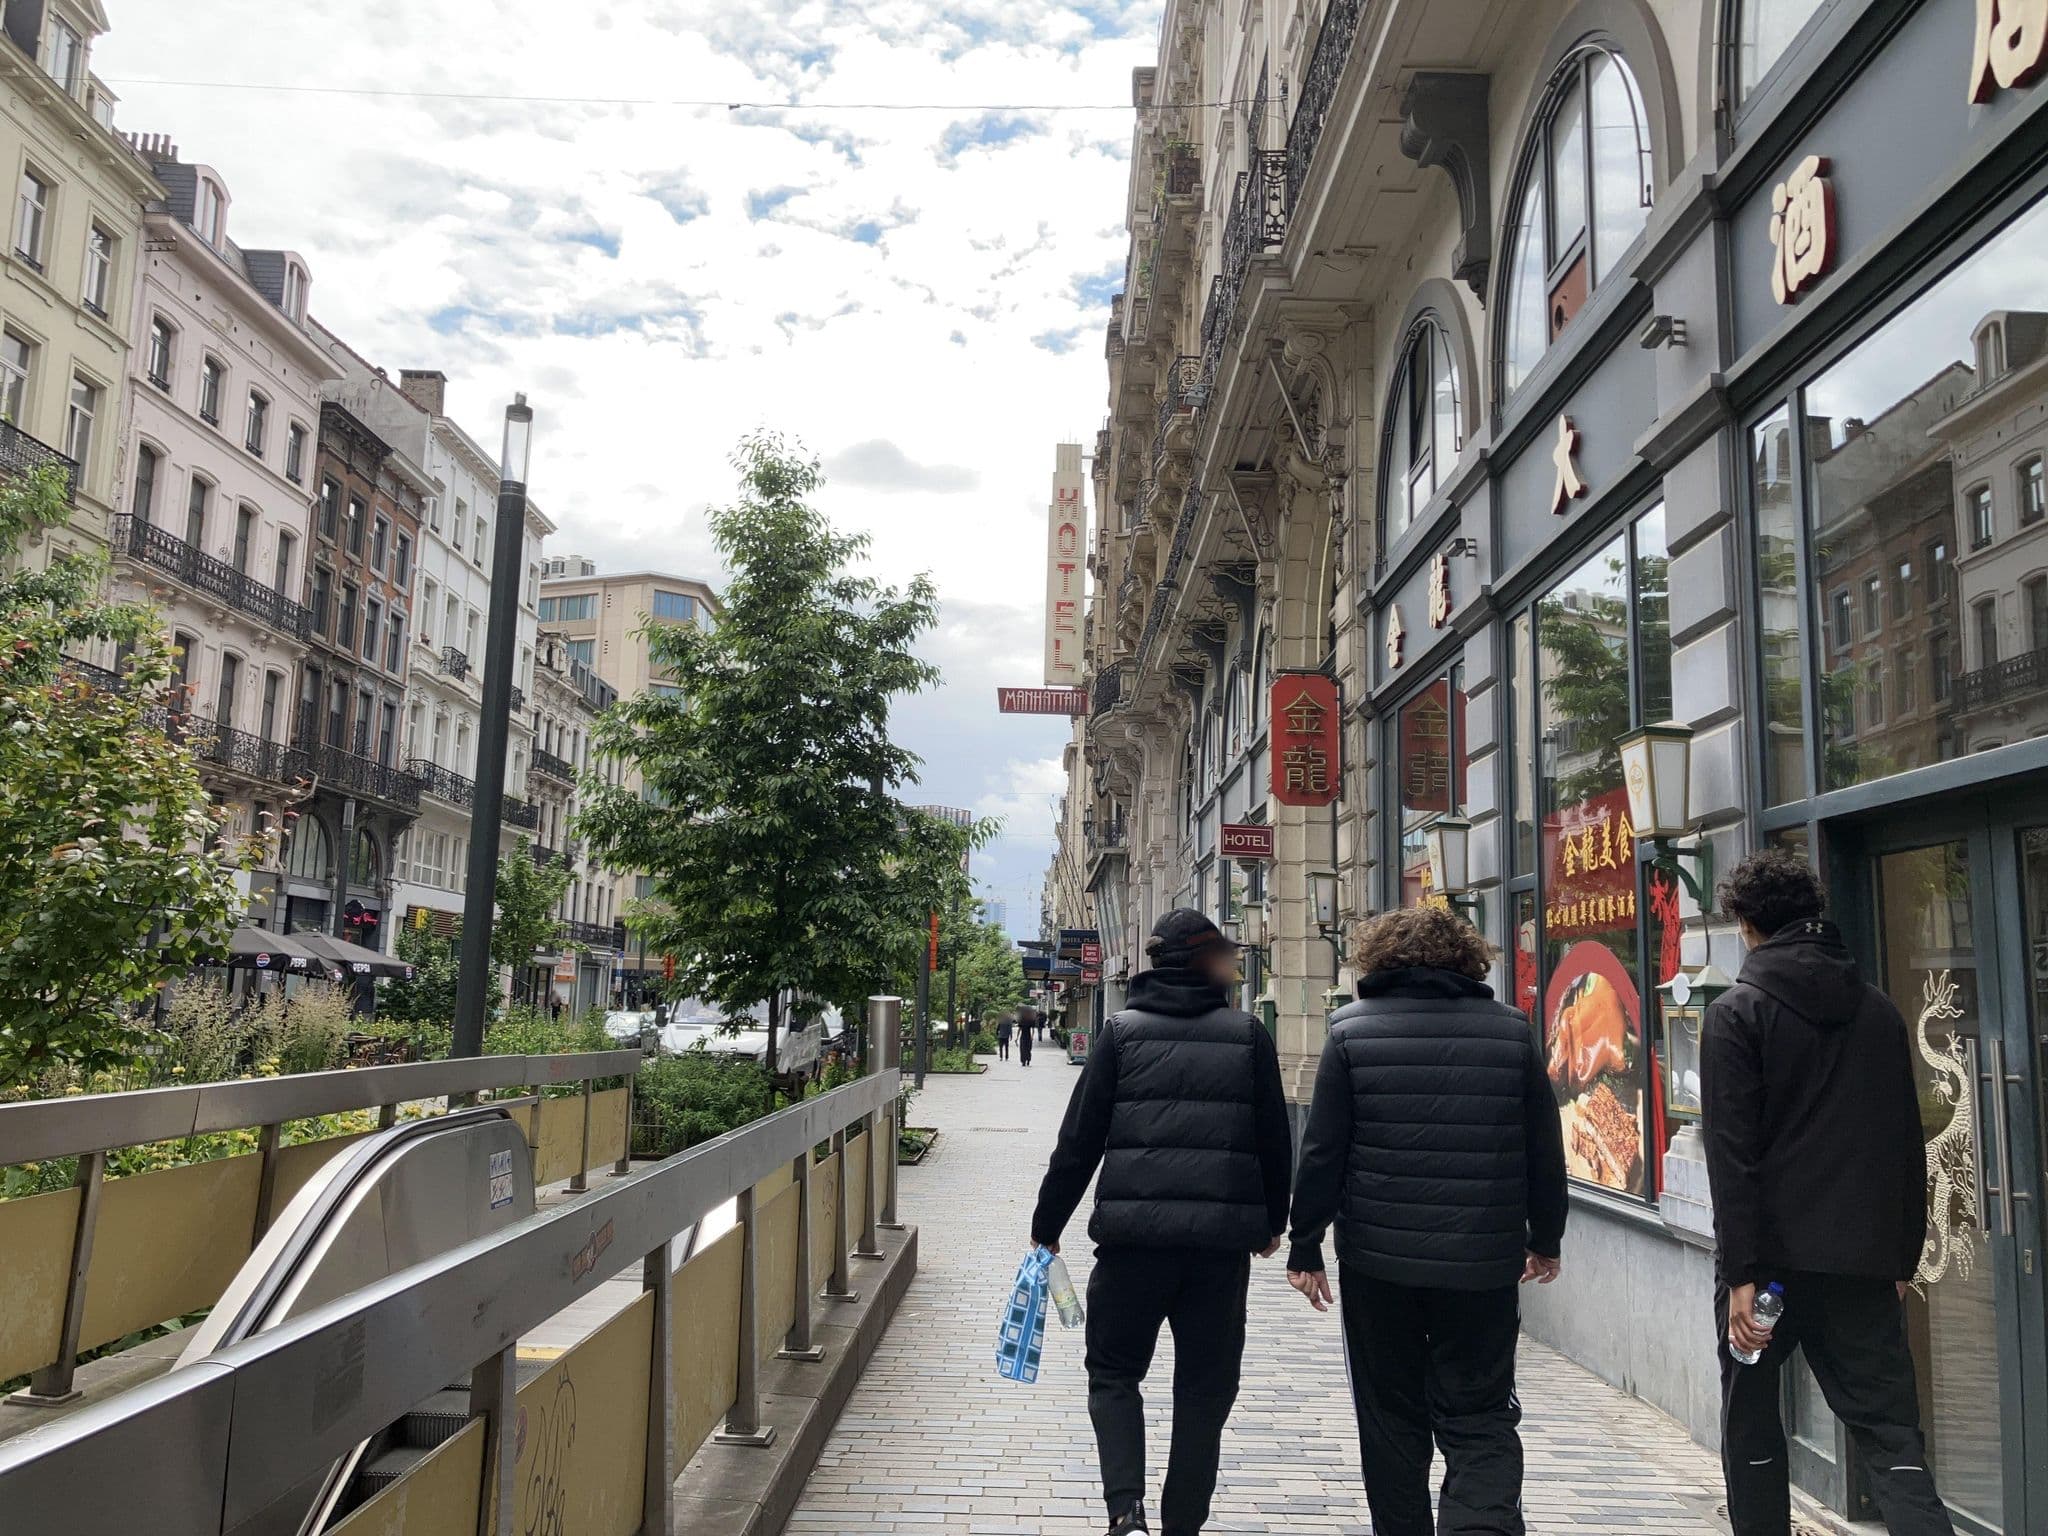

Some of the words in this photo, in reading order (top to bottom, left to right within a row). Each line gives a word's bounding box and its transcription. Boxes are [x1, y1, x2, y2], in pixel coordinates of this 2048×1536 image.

[1054, 488, 1079, 672] HOTEL
[1003, 690, 1082, 712] MANHATTAN
[1281, 689, 1331, 794] 金龍
[1224, 833, 1270, 848] HOTEL
[291, 957, 307, 967] PEPSI
[353, 963, 370, 973] PEPSI
